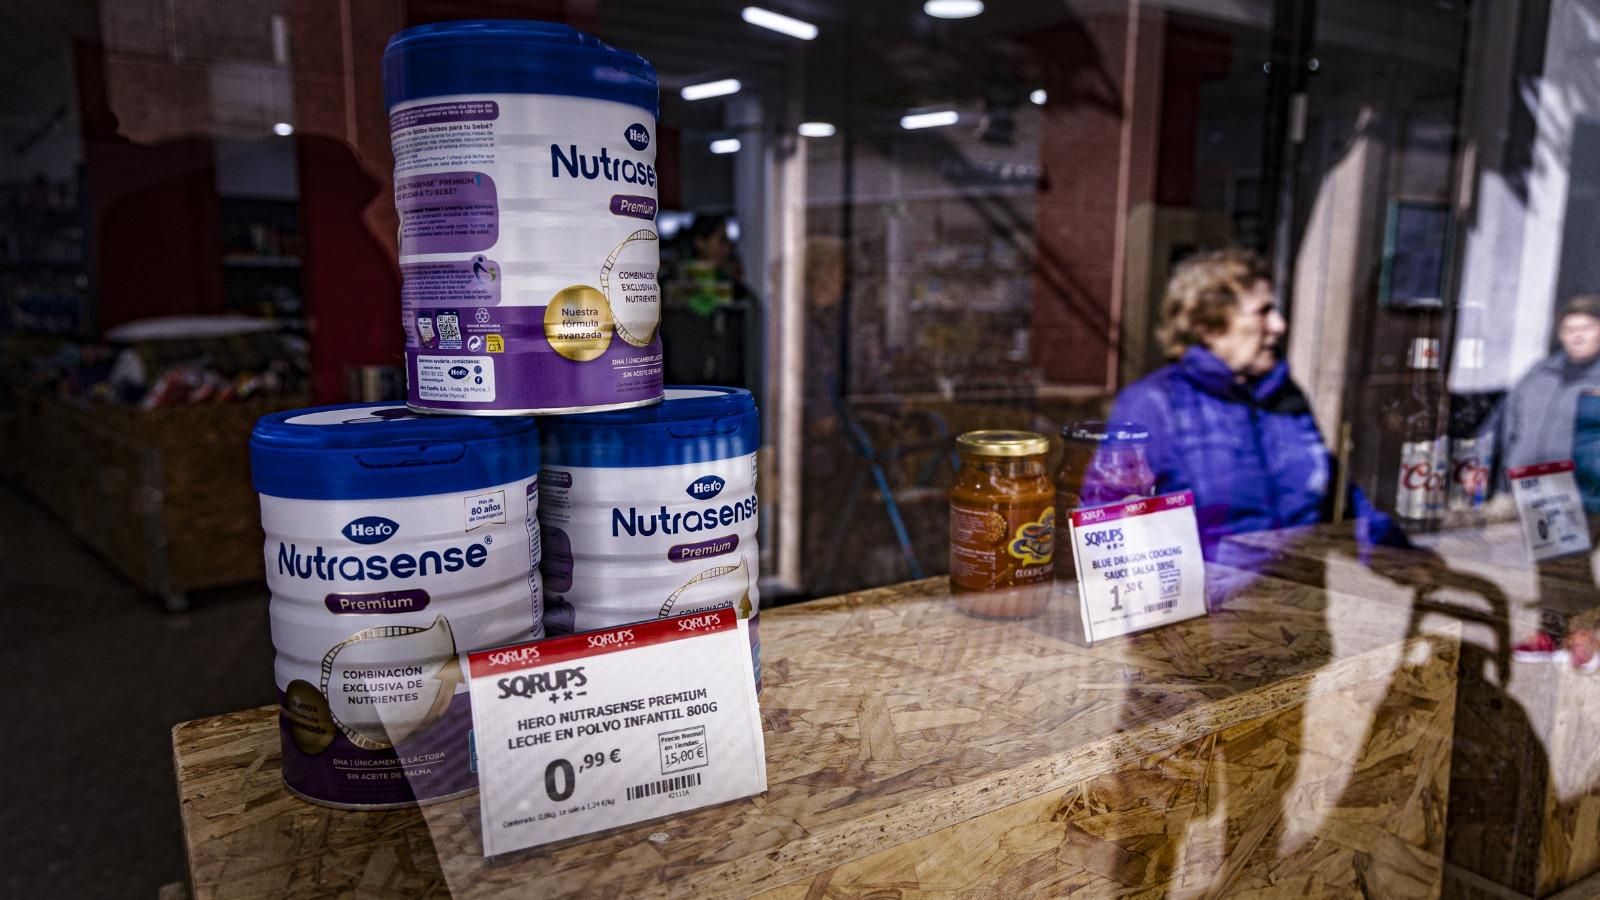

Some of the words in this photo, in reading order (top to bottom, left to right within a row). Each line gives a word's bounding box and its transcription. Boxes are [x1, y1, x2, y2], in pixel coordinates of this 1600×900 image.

[630, 129, 648, 144] Hero
[551, 144, 657, 188] Nutrase
[440, 177, 474, 186] PREMIUM
[620, 199, 654, 215] Premium
[619, 270, 655, 280] COMBINACIÓN
[625, 295, 657, 303] NUTRIENTES
[562, 308, 599, 317] Nuestra
[562, 320, 599, 328] fórmula
[558, 331, 602, 340] avanzada
[693, 480, 722, 494] Hero
[471, 507, 482, 515] 80
[484, 504, 501, 514] años
[612, 495, 757, 537] Nutrasense
[351, 523, 393, 537] Hero
[1084, 527, 1124, 547] SQRUPS
[682, 541, 731, 559] Premium
[1092, 557, 1113, 570] BLUE
[1114, 552, 1147, 566] DRAGON
[1148, 545, 1183, 561] COOKING
[1104, 568, 1129, 581] SAUCE
[1132, 563, 1156, 576] SALSA
[340, 596, 413, 610] Premium
[1110, 585, 1123, 612] 1
[678, 613, 721, 632] SQRUPS
[587, 629, 635, 648] SQRUPS
[488, 646, 541, 667] SQRUPS
[343, 665, 423, 679] COMBINACIÓN
[343, 683, 404, 693] EXCLUSIVA
[407, 680, 423, 689] DE
[498, 666, 588, 700] SQRUPS
[348, 693, 418, 705] NUTRIENTES
[517, 713, 556, 732] HERO
[560, 699, 646, 725] NUTRASENSE
[648, 687, 708, 709] PREMIUM
[508, 731, 552, 750] LECHE
[555, 728, 575, 742] EN
[577, 720, 622, 738] POLVO
[624, 708, 685, 730] INFANTIL
[687, 701, 719, 717] 800G
[660, 735, 681, 743] Precio
[681, 730, 704, 739] Normal
[674, 739, 700, 749] Tiendas:
[332, 758, 348, 767] DHA
[354, 757, 407, 767] ÚNICAMENTE
[665, 749, 694, 765] 15,00
[697, 747, 704, 758] €
[347, 772, 359, 781] SIN
[360, 772, 389, 781] ACEITE
[391, 771, 401, 780] DE
[403, 768, 432, 778] PALMA
[544, 758, 576, 802] 0
[578, 752, 605, 773] ,99
[609, 748, 622, 764] €
[668, 789, 691, 799] 42111A
[503, 815, 537, 829] Contenido:
[559, 808, 567, 816] Le
[568, 806, 580, 814] sale
[586, 802, 601, 811] 1,24
[601, 798, 616, 808] €/kg
